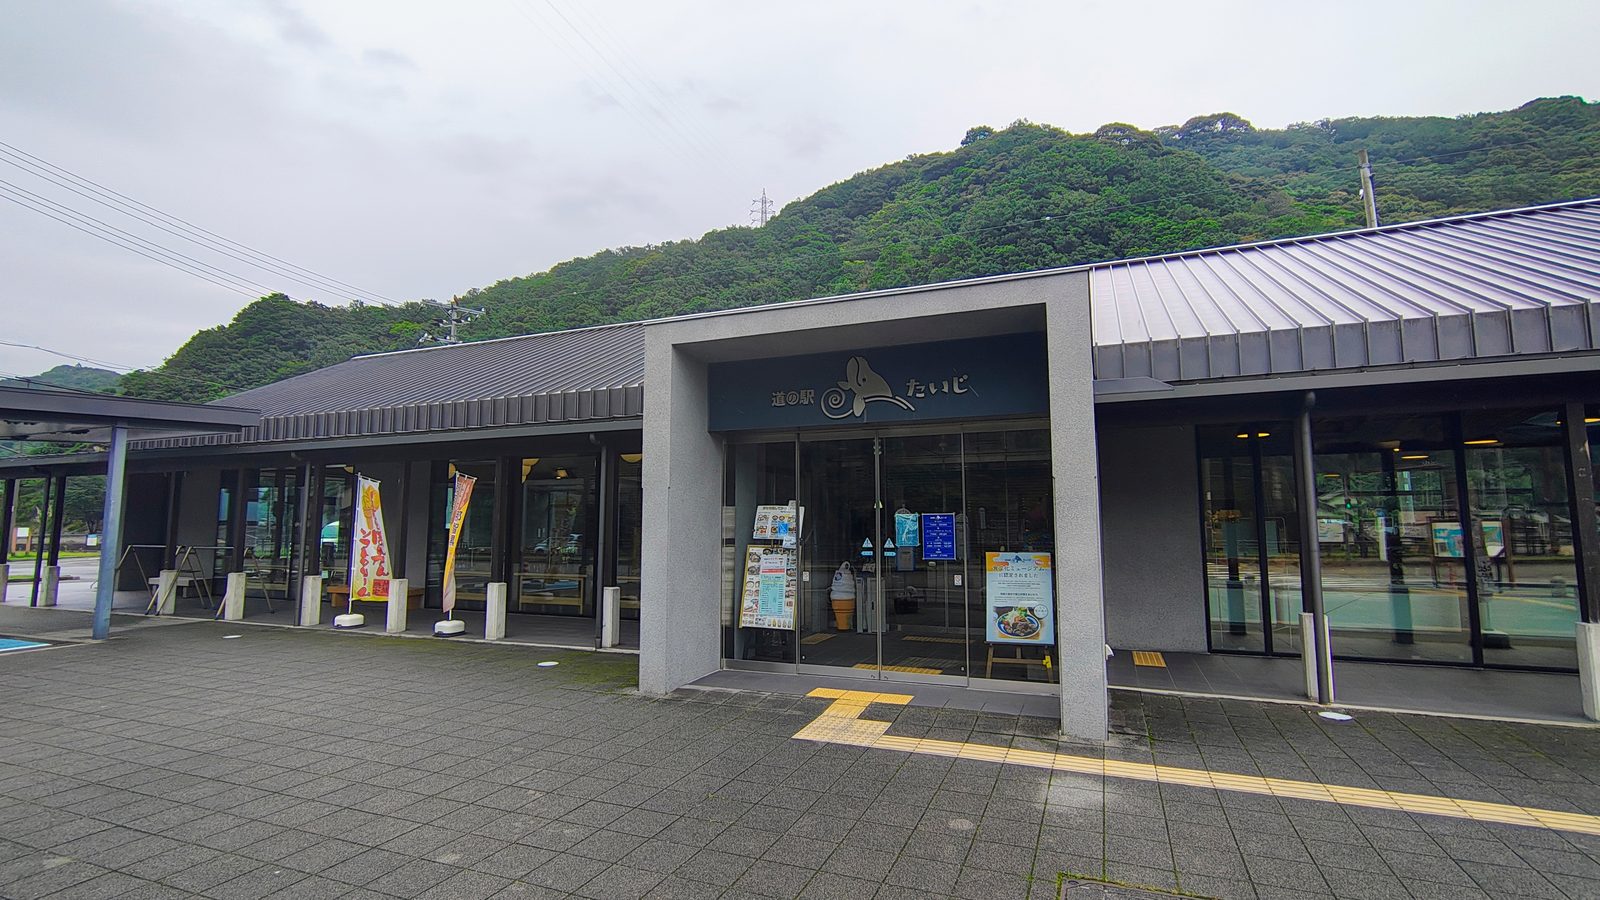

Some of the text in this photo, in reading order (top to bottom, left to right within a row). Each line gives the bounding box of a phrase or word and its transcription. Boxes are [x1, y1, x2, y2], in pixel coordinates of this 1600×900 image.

[771, 374, 969, 407] 道の駅 たいじ
